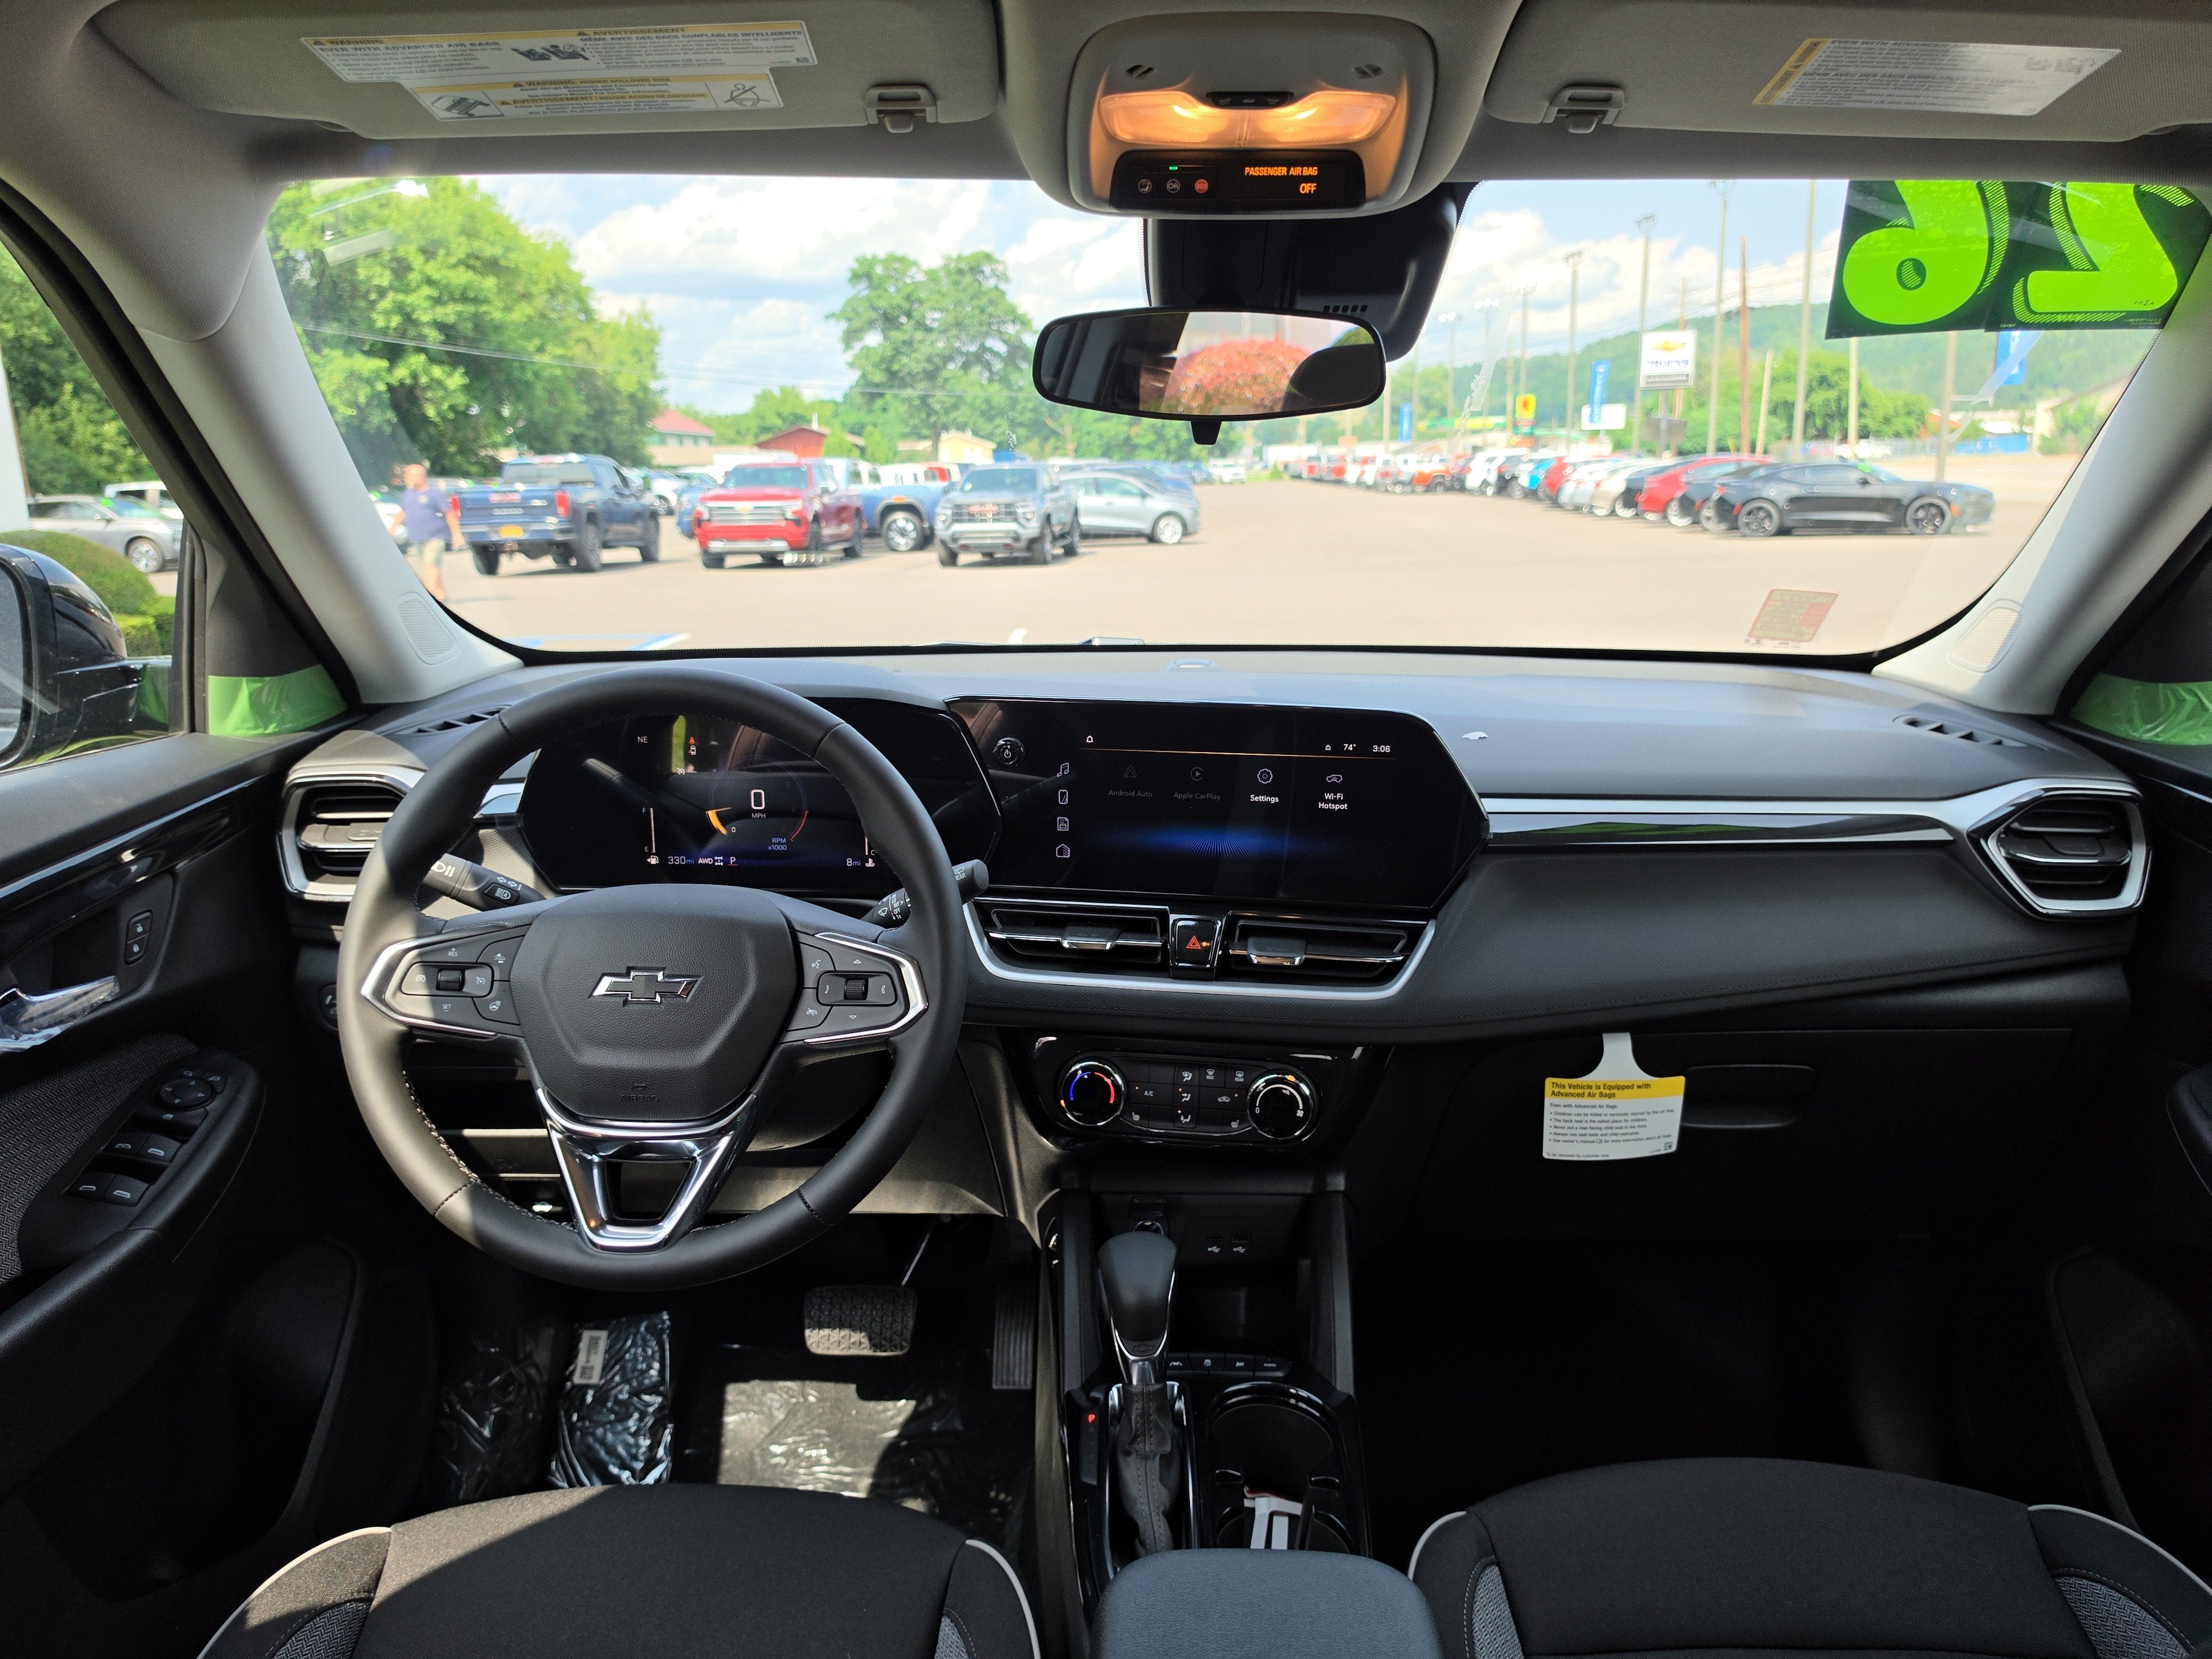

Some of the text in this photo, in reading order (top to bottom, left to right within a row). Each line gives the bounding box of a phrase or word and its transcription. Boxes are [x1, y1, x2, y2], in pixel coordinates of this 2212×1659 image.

[1245, 167, 1318, 176] PASSENGER AIR BAG
[1300, 183, 1317, 194] OFF
[1343, 743, 1356, 751] 74°
[750, 789, 766, 810] 0
[1173, 792, 1221, 801] Apple CarPlay
[1250, 794, 1279, 803] Settings
[1324, 792, 1343, 801] Wi-Fi
[1319, 802, 1348, 811] Hotspot
[730, 856, 736, 864] P
[1551, 1082, 1566, 1090] This
[1567, 1082, 1593, 1090] Vehicle
[1603, 1083, 1634, 1091] Equipped
[1551, 1090, 1585, 1098] Advanced
